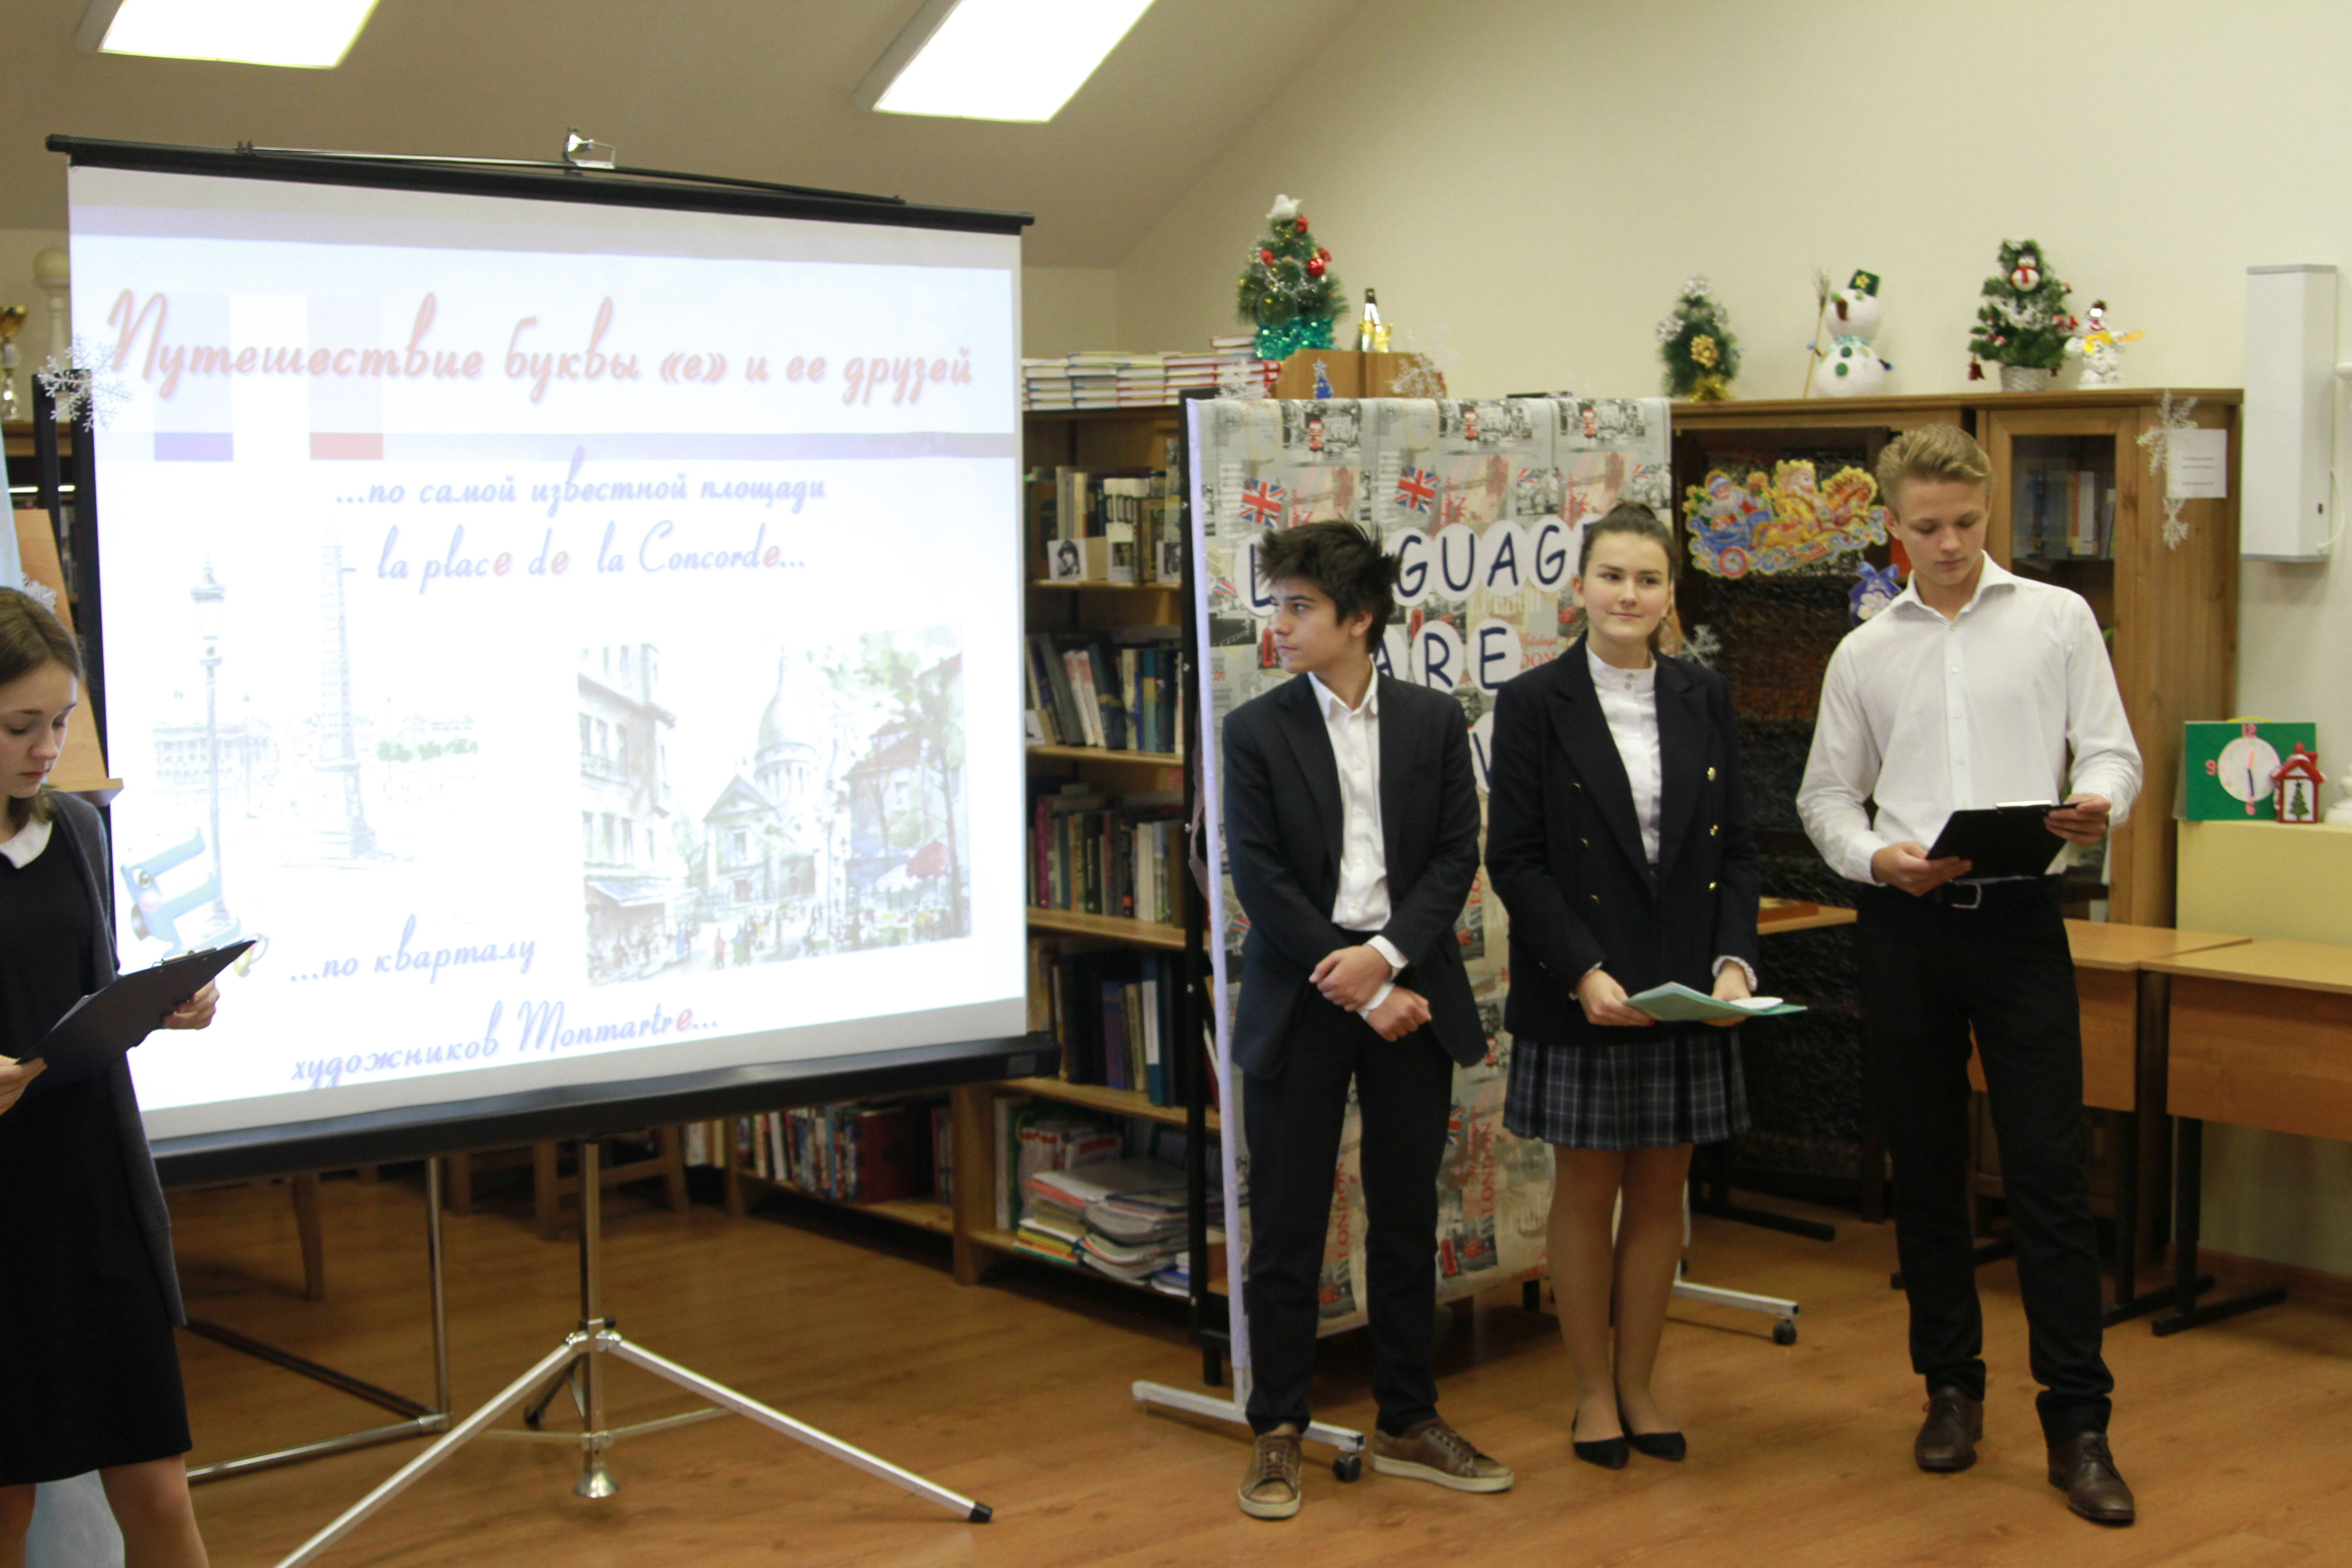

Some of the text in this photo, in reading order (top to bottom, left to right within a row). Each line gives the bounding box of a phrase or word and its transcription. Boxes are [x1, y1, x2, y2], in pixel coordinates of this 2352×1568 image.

[108, 289, 483, 399] Путешествие
[504, 296, 640, 403] буквы
[745, 356, 769, 384] и
[786, 355, 827, 384] ее
[843, 347, 973, 405] друзей
[419, 475, 516, 504] самой
[531, 444, 688, 518] известной
[700, 480, 827, 515] площади
[377, 524, 408, 579] la
[418, 524, 513, 594] place
[528, 526, 570, 575] de
[597, 520, 624, 573] la
[639, 519, 805, 573] Concorde...
[1373, 627, 1507, 689] ARE
[373, 913, 536, 985] кварталу
[290, 1000, 503, 1088] художников
